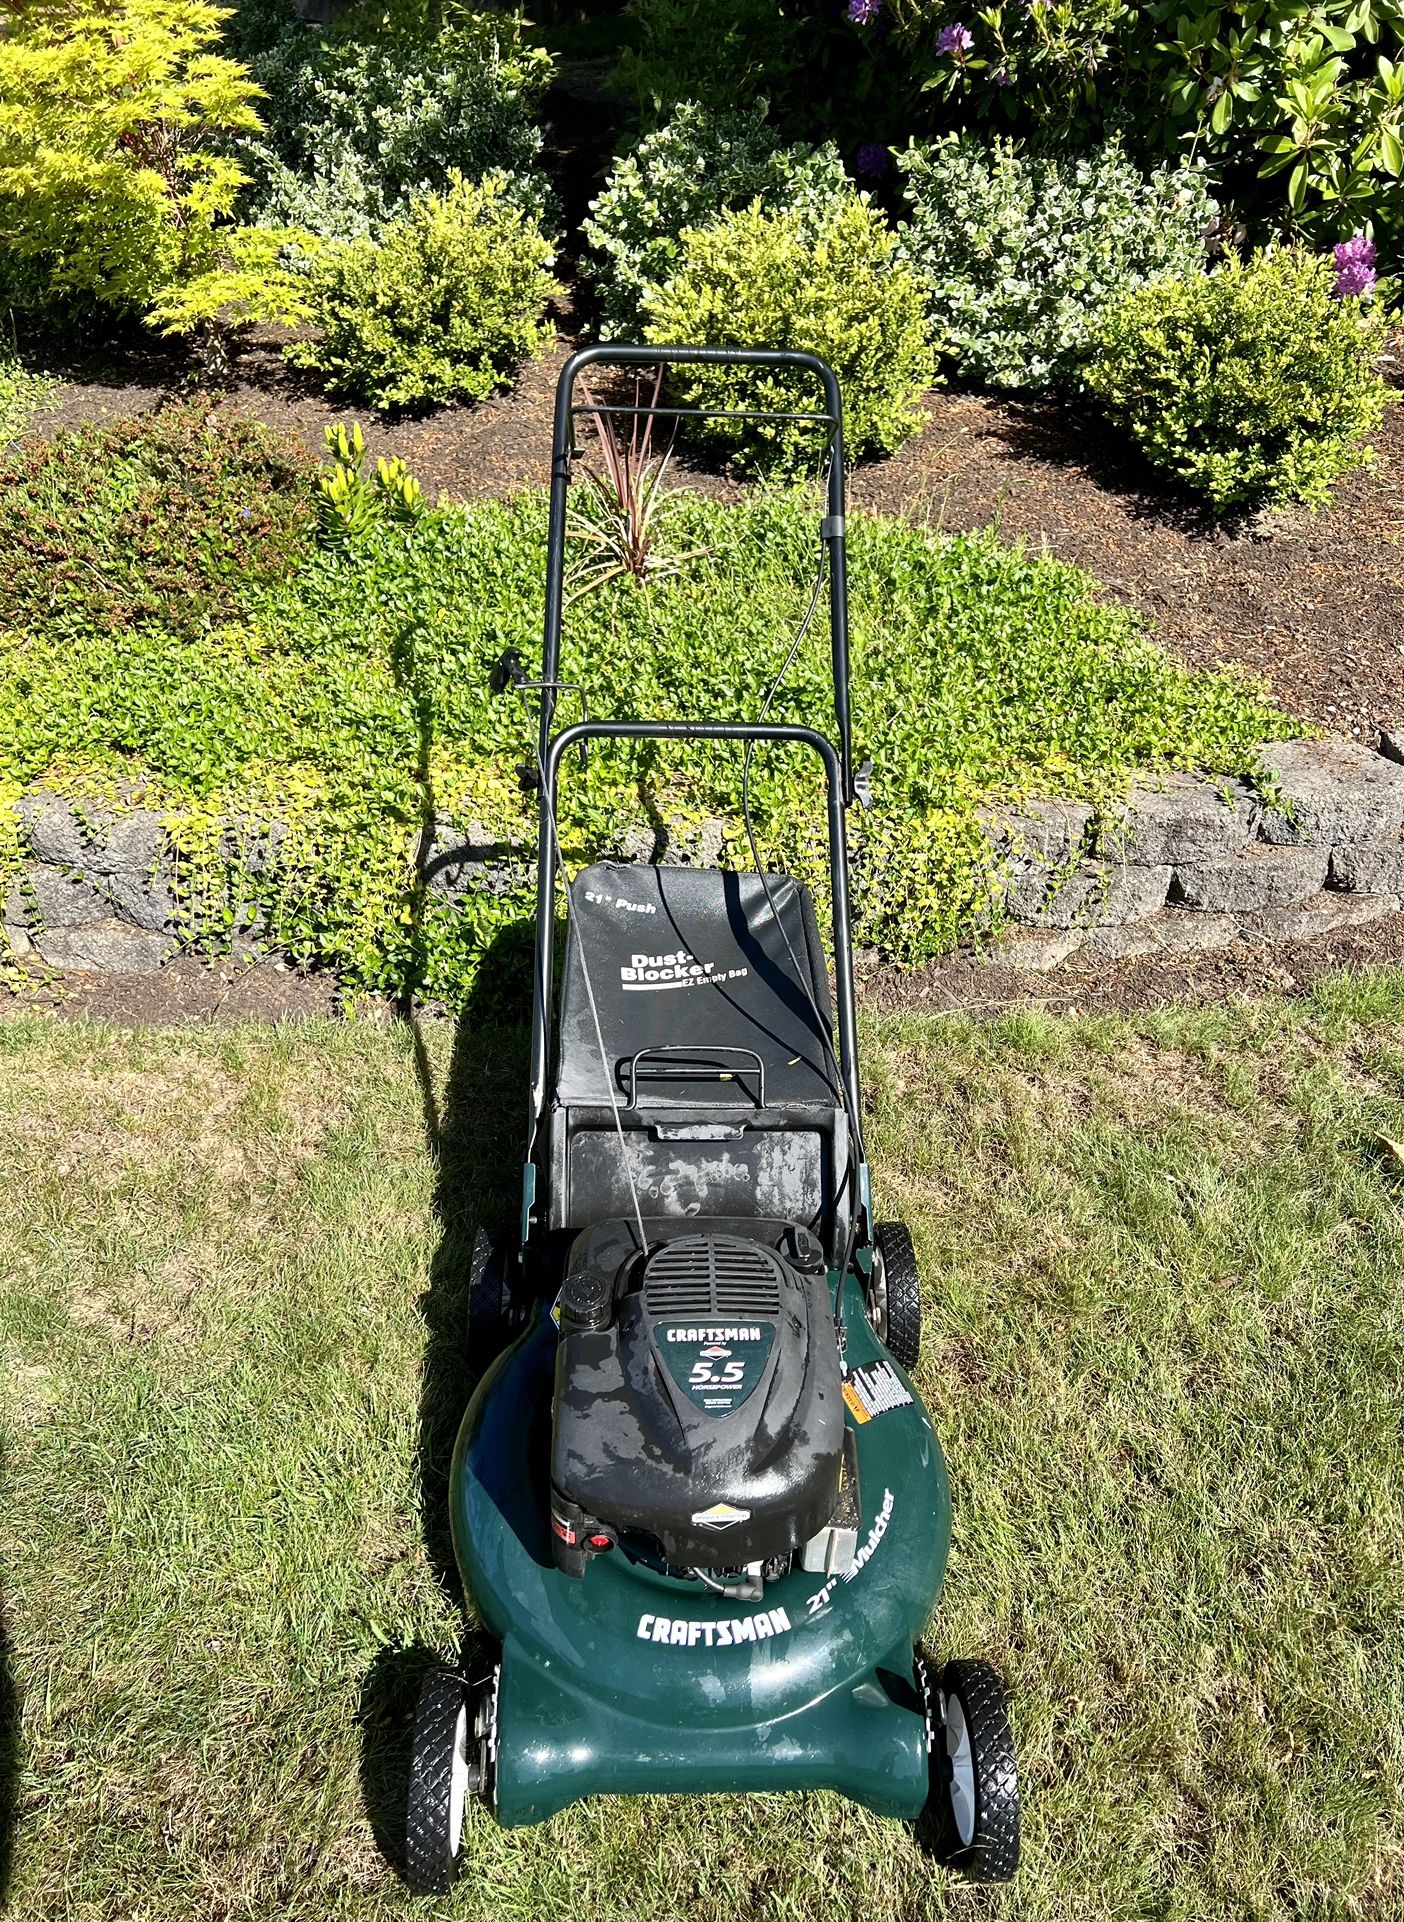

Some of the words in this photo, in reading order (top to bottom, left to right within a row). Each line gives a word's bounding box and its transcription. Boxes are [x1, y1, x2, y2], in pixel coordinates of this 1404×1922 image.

[584, 891, 612, 904] 21"
[615, 899, 657, 914] Push
[631, 950, 694, 968] Dust-
[620, 962, 715, 981] Blocker
[682, 978, 695, 987] EZ
[728, 967, 748, 978] Bag
[666, 1327, 761, 1342] CRAFTSMAN
[688, 1361, 746, 1383] 5.5
[805, 1578, 837, 1615] 21"
[844, 1488, 895, 1580] Mulcher
[637, 1606, 792, 1647] CRAFTSMAN
